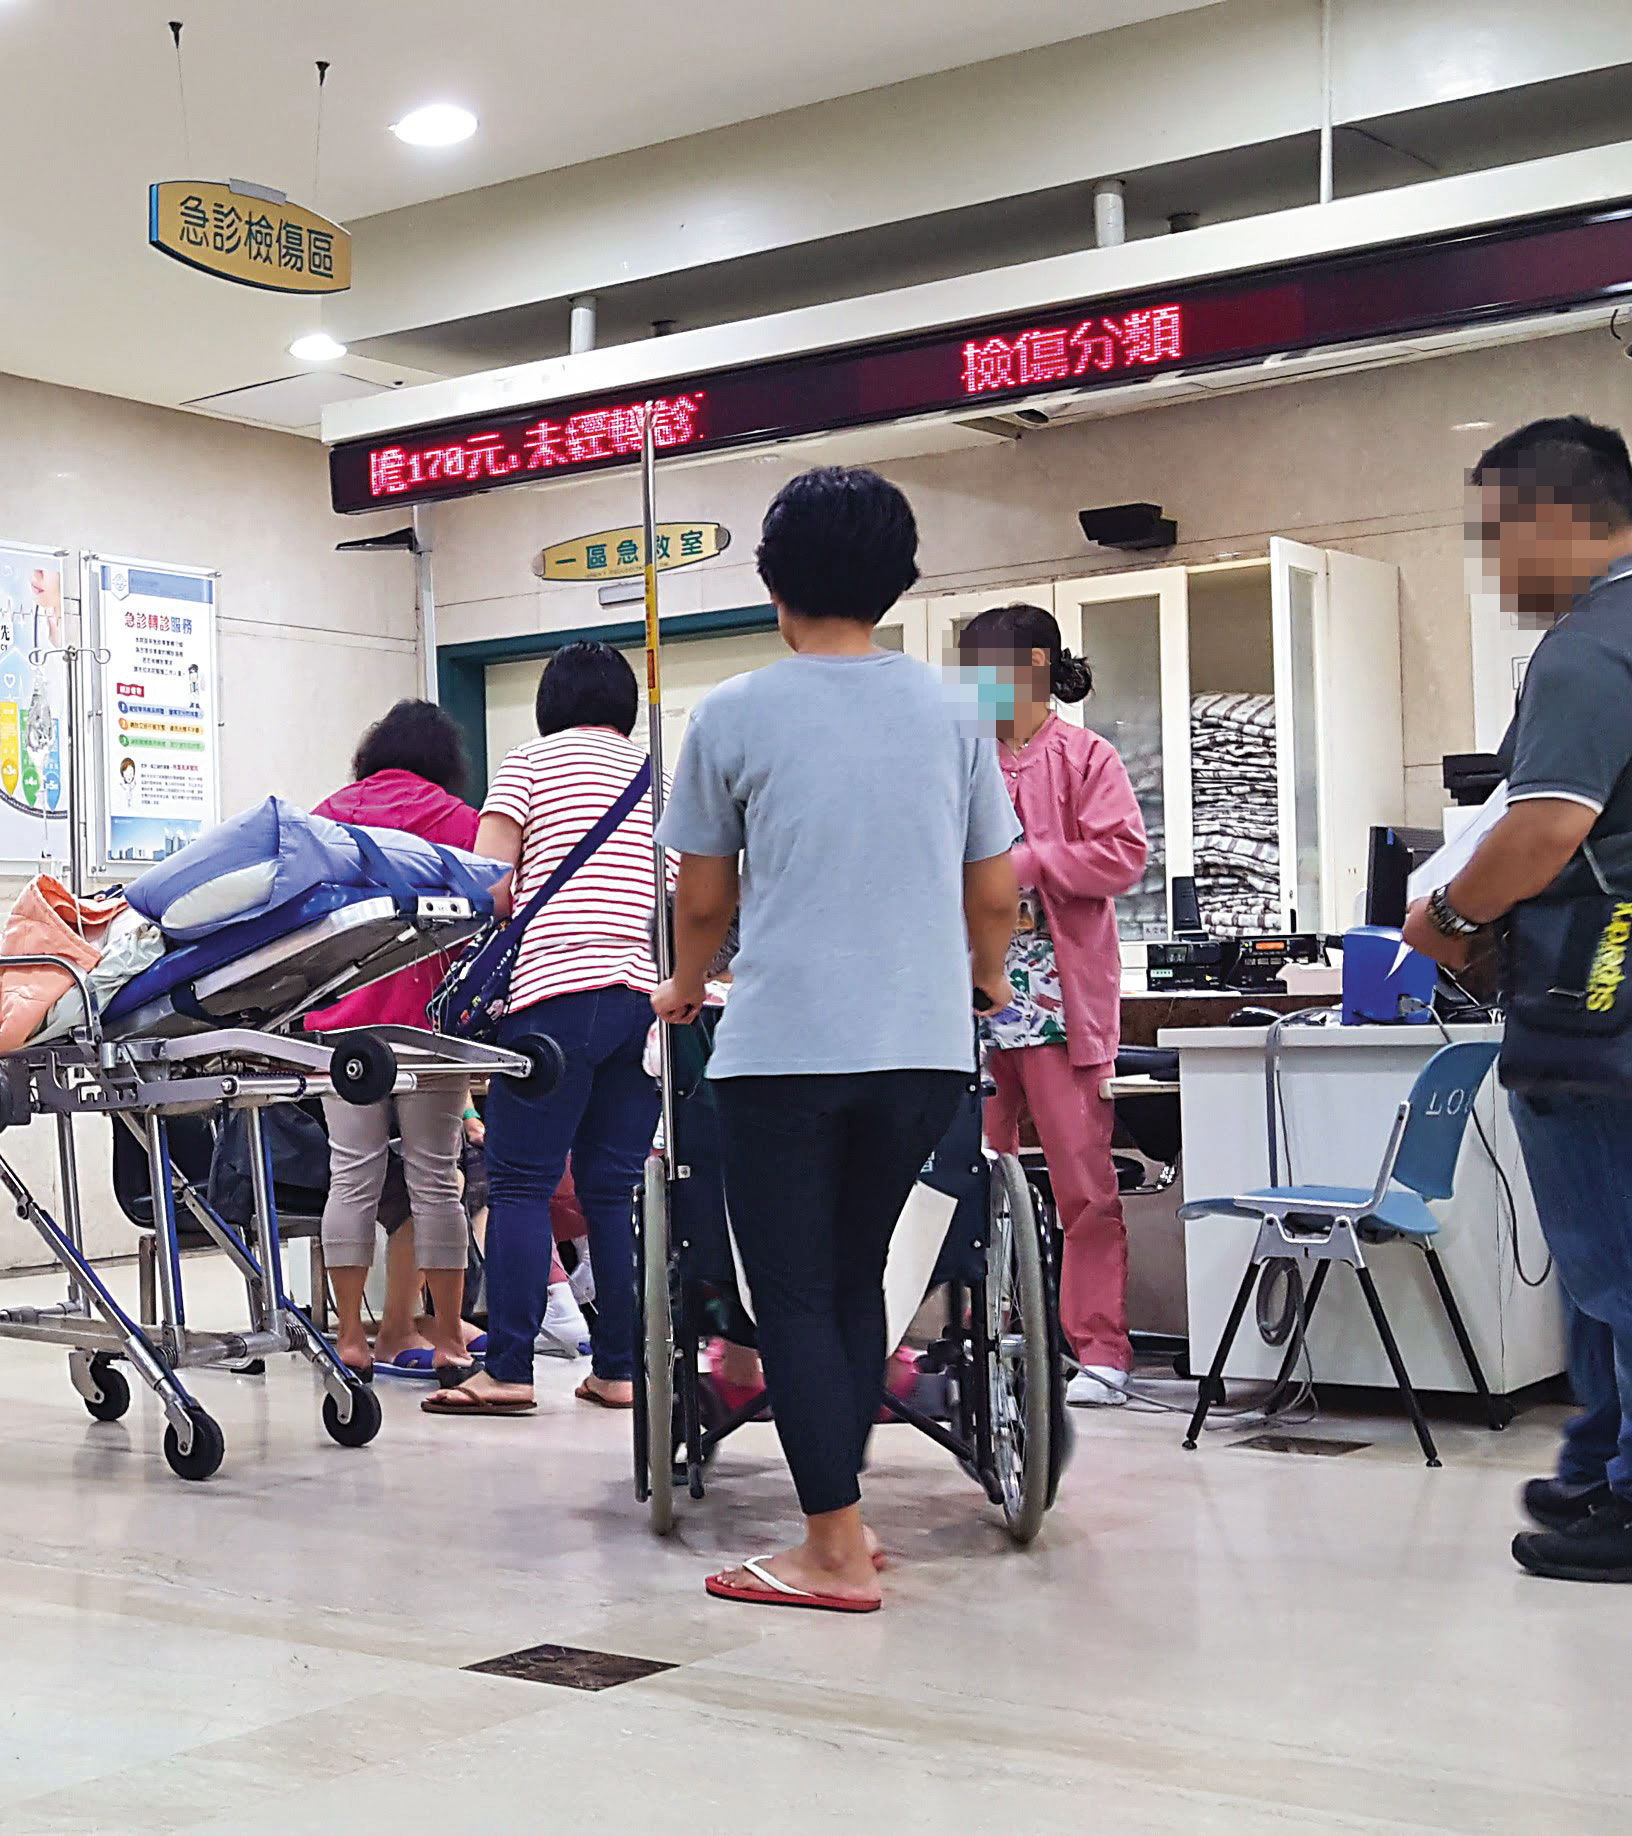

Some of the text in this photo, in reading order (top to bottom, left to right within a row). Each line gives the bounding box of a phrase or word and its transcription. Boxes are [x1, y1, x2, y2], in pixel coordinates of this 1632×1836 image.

[179, 195, 335, 280] 急診檢傷區
[961, 306, 1181, 392] 檢傷分類
[124, 611, 193, 635] 急診轉診服務
